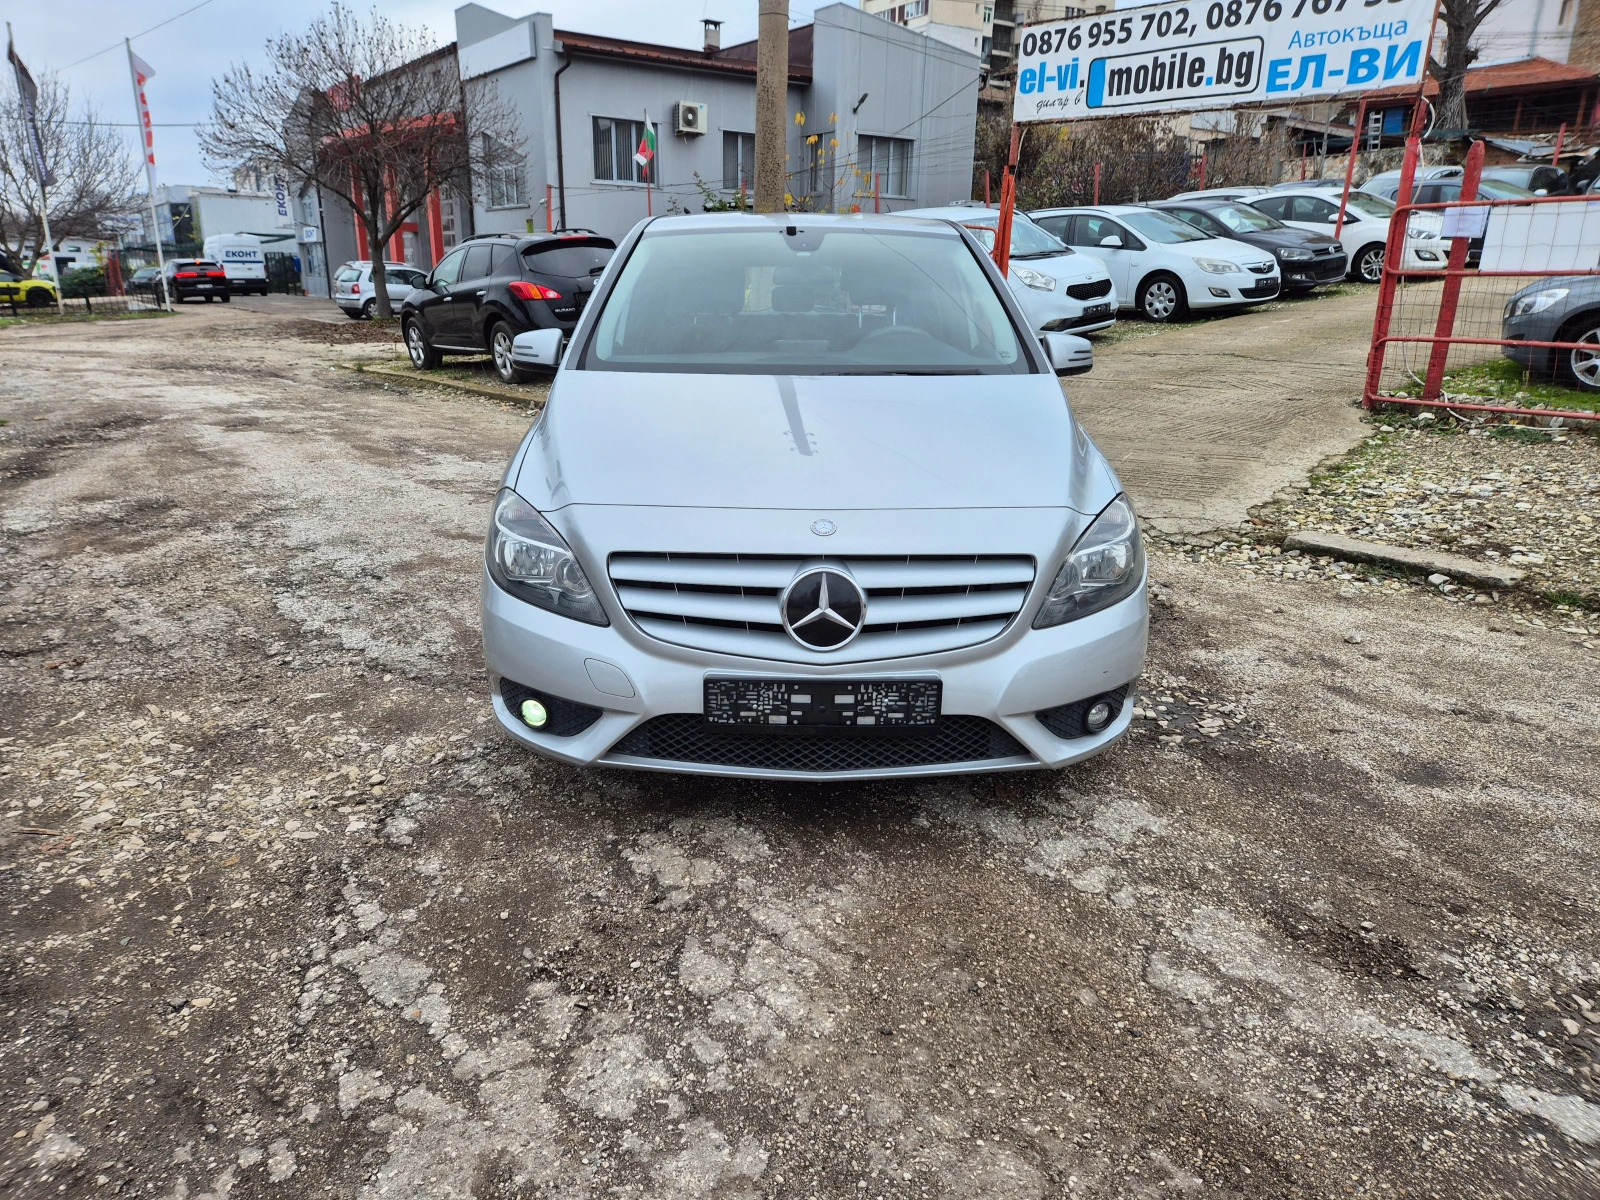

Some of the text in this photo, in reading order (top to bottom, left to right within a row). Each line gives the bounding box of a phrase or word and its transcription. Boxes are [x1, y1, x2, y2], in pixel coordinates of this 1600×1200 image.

[1022, 25, 1082, 57] 0876
[1088, 17, 1133, 49] 955
[1139, 7, 1198, 41] 702,
[1206, 0, 1283, 31] 0876
[1287, 20, 1408, 50] Автокъща
[1108, 47, 1255, 97] mobile.bg
[1265, 40, 1423, 93] ЕЛ-ВИ
[225, 250, 258, 258] ЕКОНТ
